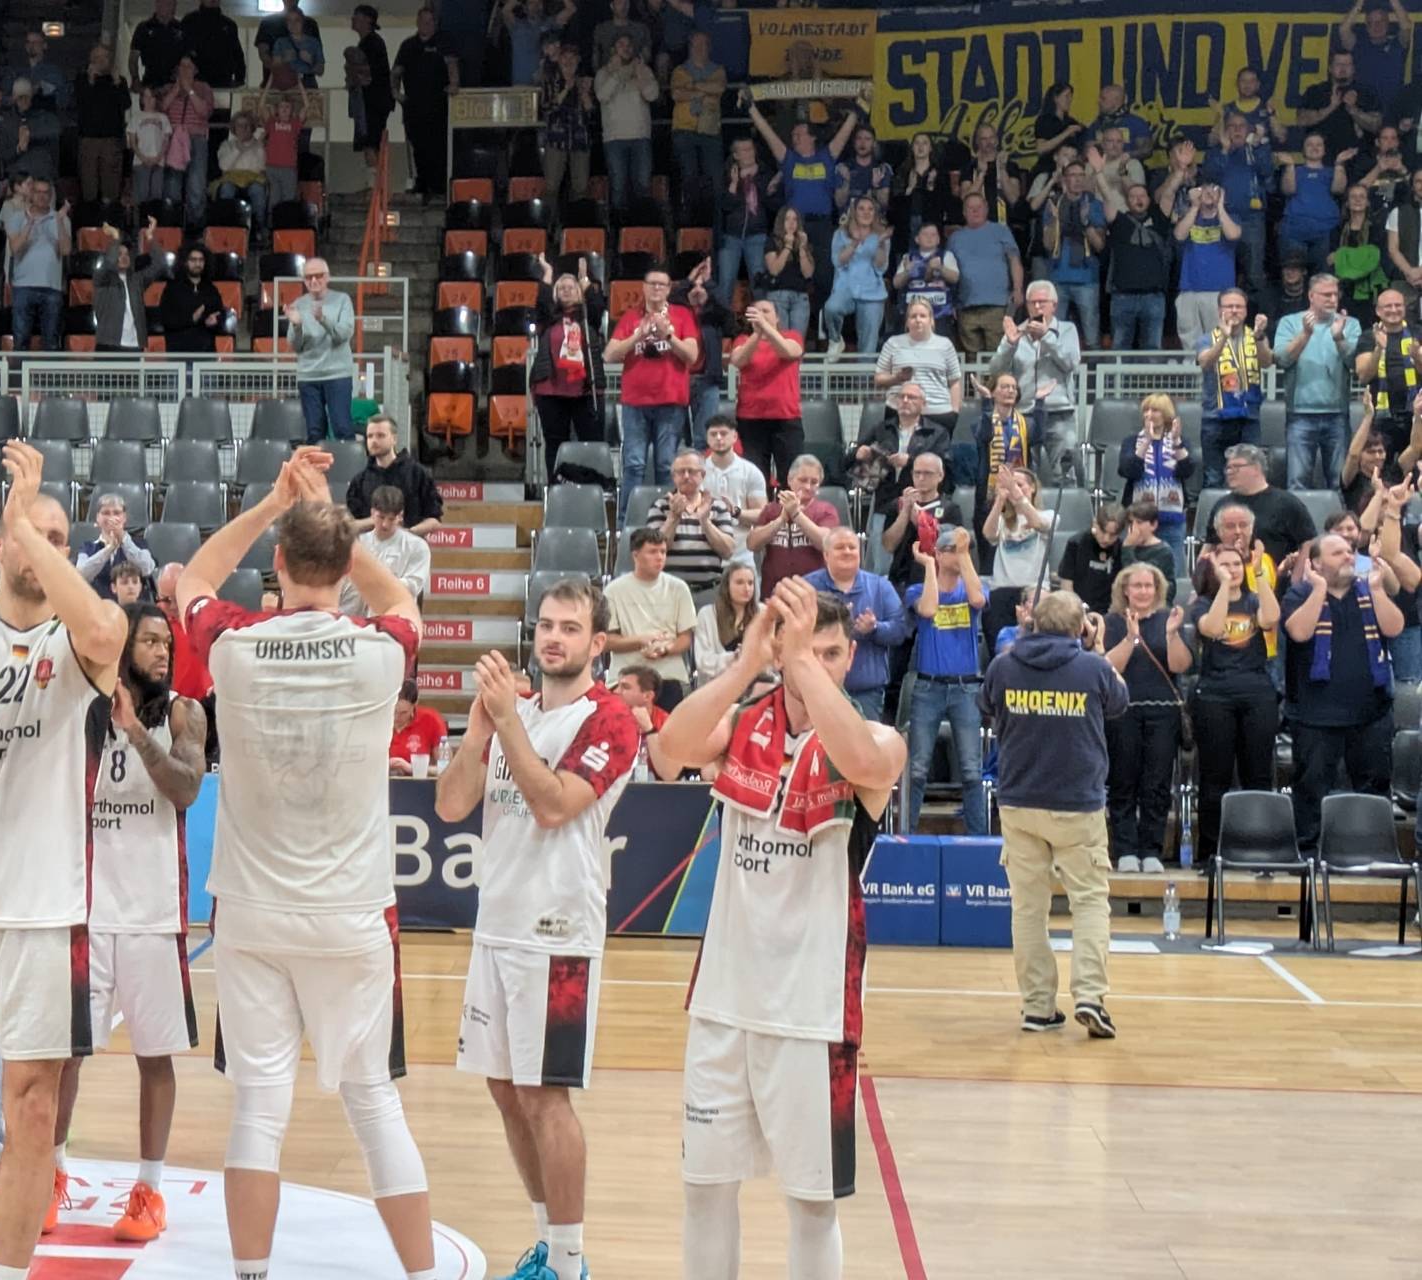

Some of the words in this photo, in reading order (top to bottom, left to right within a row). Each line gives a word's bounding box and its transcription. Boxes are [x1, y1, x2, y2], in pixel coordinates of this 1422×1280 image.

[758, 22, 870, 37] VOLMESTADT
[886, 28, 1083, 127] STADT
[1100, 21, 1226, 110] UND
[469, 486, 477, 498] 8
[458, 531, 467, 544] 7
[437, 577, 473, 590] Reihe
[476, 577, 485, 590] 6
[458, 625, 466, 637] 5
[255, 637, 357, 661] URBANSKY
[416, 674, 444, 687] eihe
[446, 674, 455, 687] 4
[1005, 689, 1088, 711] PHOENIX
[109, 750, 127, 783] 8
[92, 799, 155, 815] rthomol
[91, 815, 122, 830] port
[861, 883, 878, 895] VR
[882, 882, 914, 896] Bank
[917, 884, 936, 896] eG
[966, 884, 984, 897] VR
[988, 885, 1011, 898] Ban
